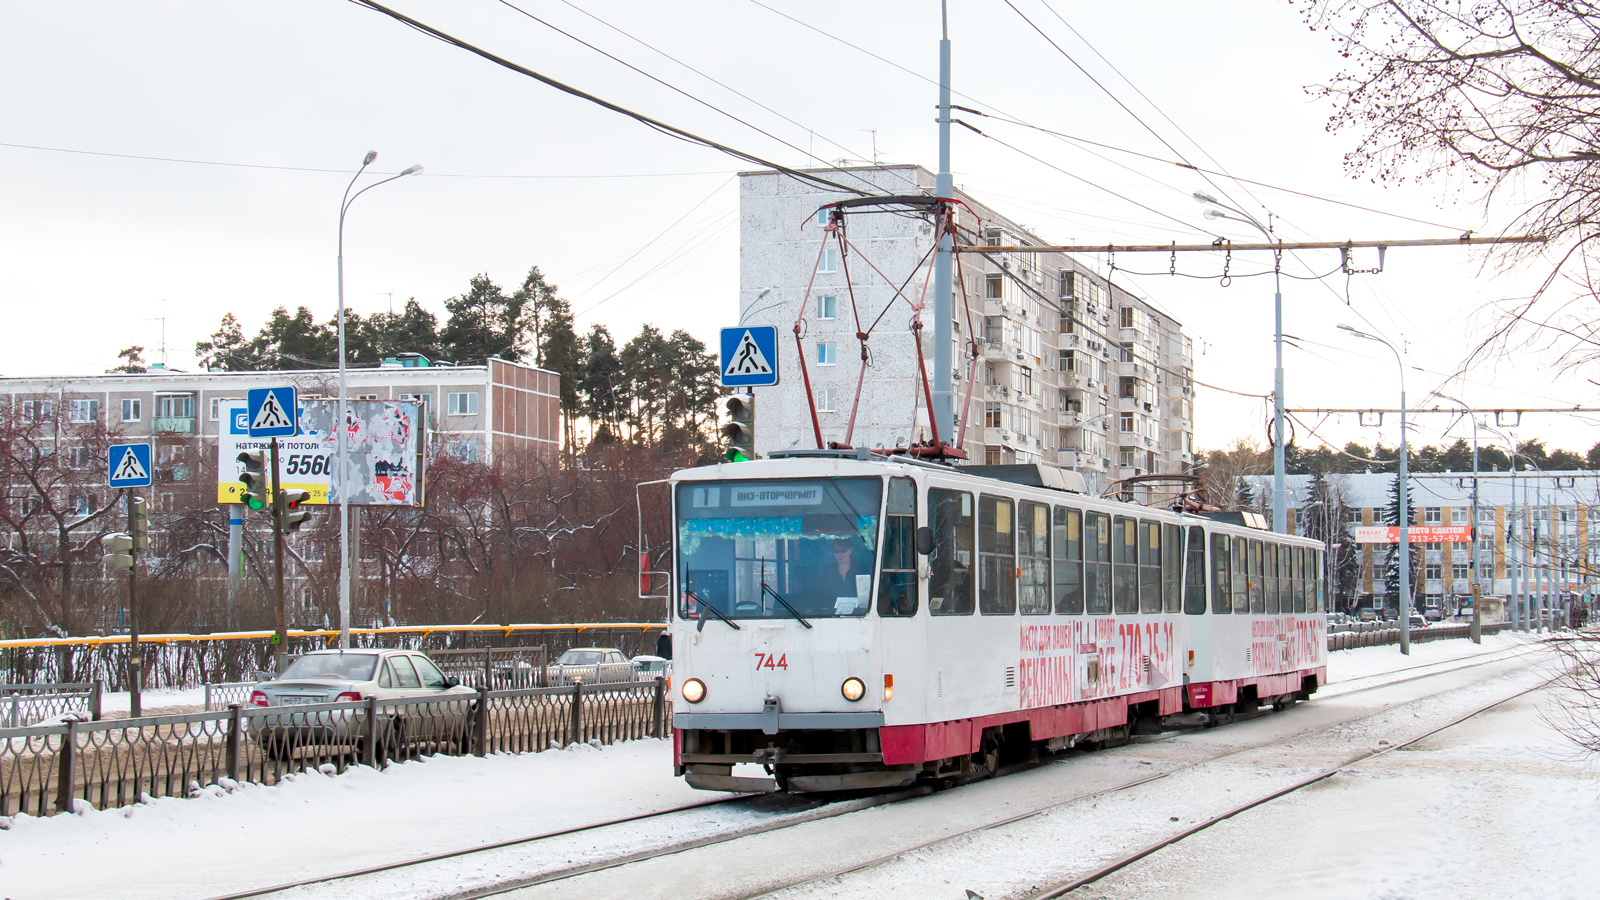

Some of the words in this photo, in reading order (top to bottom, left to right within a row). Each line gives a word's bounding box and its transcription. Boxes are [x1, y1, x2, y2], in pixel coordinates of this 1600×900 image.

[235, 440, 285, 450] натяжнй
[703, 488, 709, 506] 1
[754, 652, 788, 671] 744
[1098, 646, 1116, 697] ВСЕ
[1019, 655, 1073, 709] РЕКЛАМЫ
